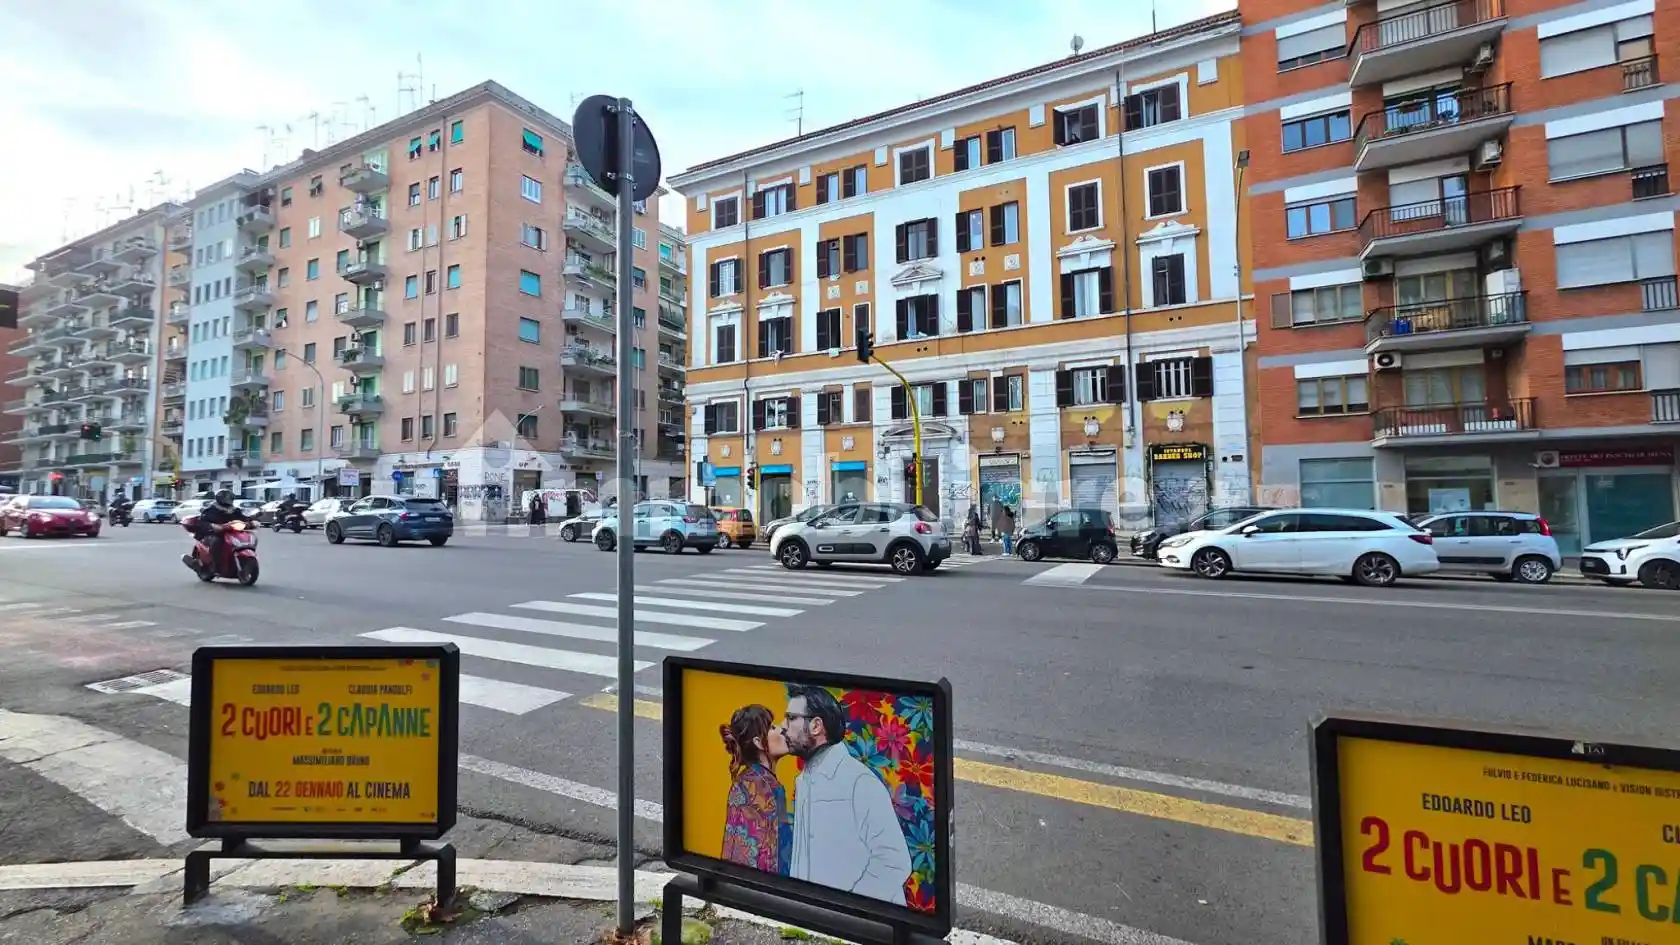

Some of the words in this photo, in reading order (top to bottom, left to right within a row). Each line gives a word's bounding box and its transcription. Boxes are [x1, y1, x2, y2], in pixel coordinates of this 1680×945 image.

[286, 684, 300, 695] LEO
[221, 702, 236, 736] 2
[241, 706, 302, 741] CUORI
[305, 715, 314, 736] E
[317, 702, 332, 736] 2
[337, 702, 431, 738] CAPANNE
[248, 781, 271, 798] DAL
[274, 781, 291, 798] 22
[295, 780, 344, 798] GENNAIO
[346, 783, 361, 799] AL
[365, 782, 411, 799] CINEMA
[1483, 766, 1512, 780] FULVIO
[1521, 771, 1563, 786] FEDERICA
[1565, 776, 1611, 792] LUCISANO
[1620, 783, 1652, 798] VISION
[1422, 793, 1495, 819] EDOARDO
[1501, 804, 1531, 824] LEO
[1360, 816, 1391, 875] 2
[1403, 830, 1540, 900] CUORI
[1552, 868, 1573, 906] E
[1582, 848, 1621, 914] 2
